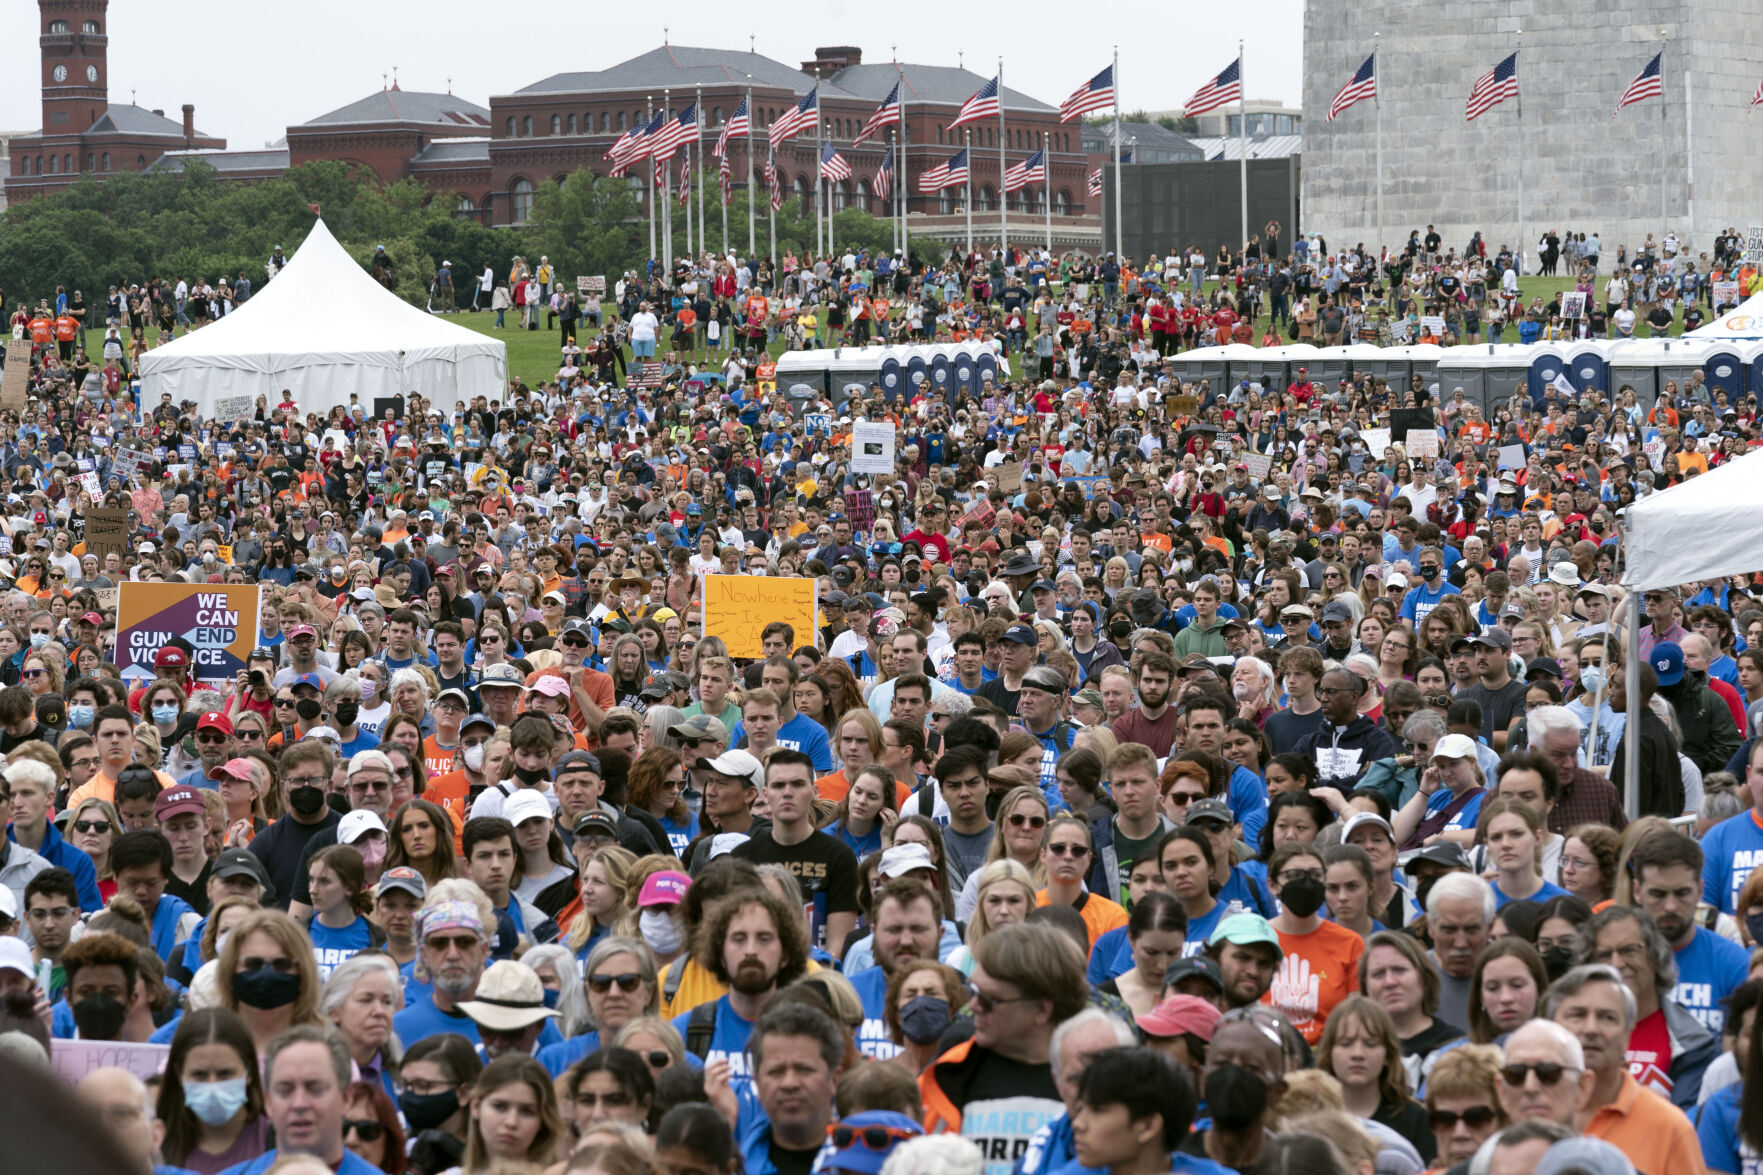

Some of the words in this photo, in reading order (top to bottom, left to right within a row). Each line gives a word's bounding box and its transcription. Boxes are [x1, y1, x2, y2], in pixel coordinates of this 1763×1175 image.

[197, 593, 229, 609] WE
[721, 581, 789, 604] Nowhere
[196, 610, 239, 626] CAN
[129, 630, 173, 648] GUN
[195, 627, 238, 644] END
